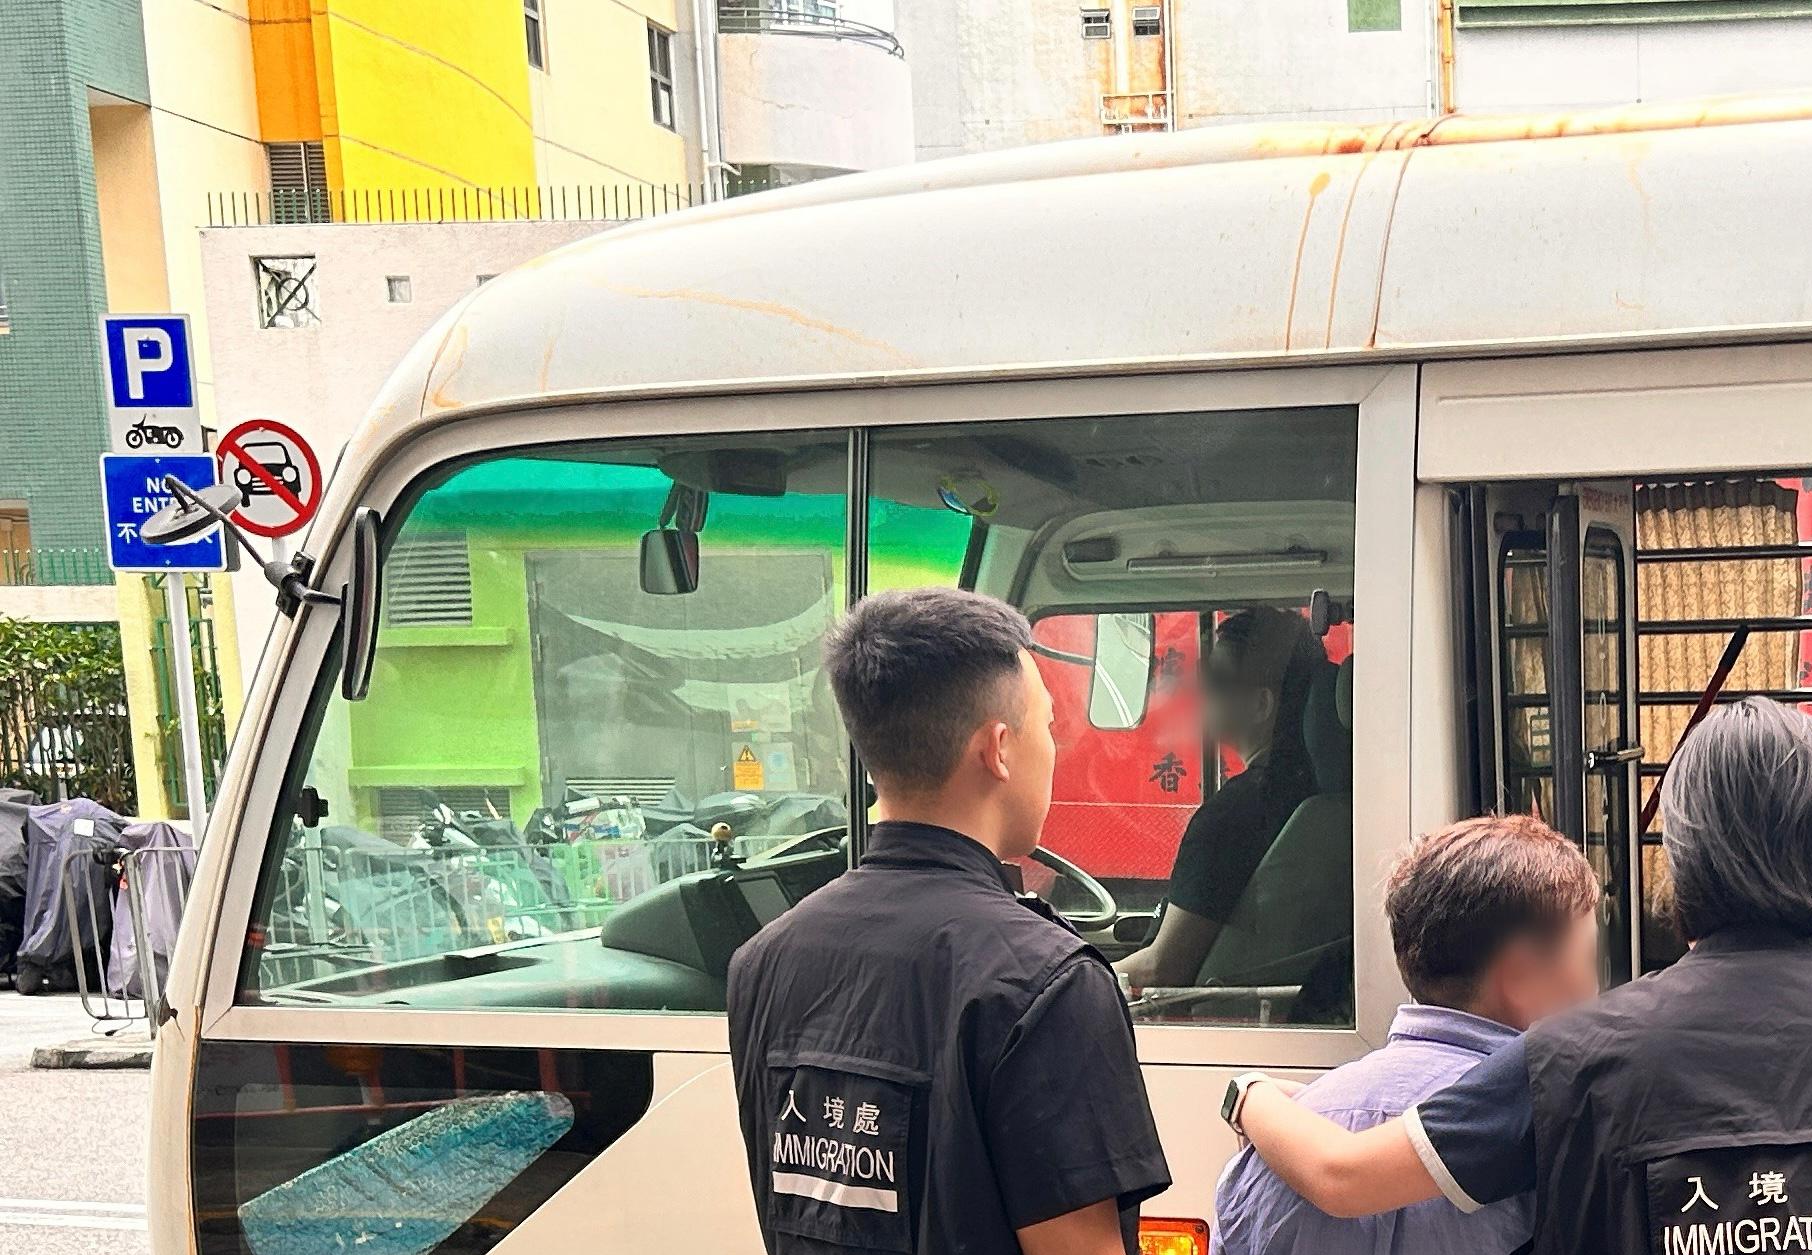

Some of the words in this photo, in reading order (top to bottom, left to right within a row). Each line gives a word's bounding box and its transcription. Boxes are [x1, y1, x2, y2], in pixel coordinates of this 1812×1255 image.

[123, 327, 173, 399] P
[132, 497, 178, 513] ENT
[1150, 752, 1187, 793] 香
[773, 1132, 895, 1183] IMMIGRATION
